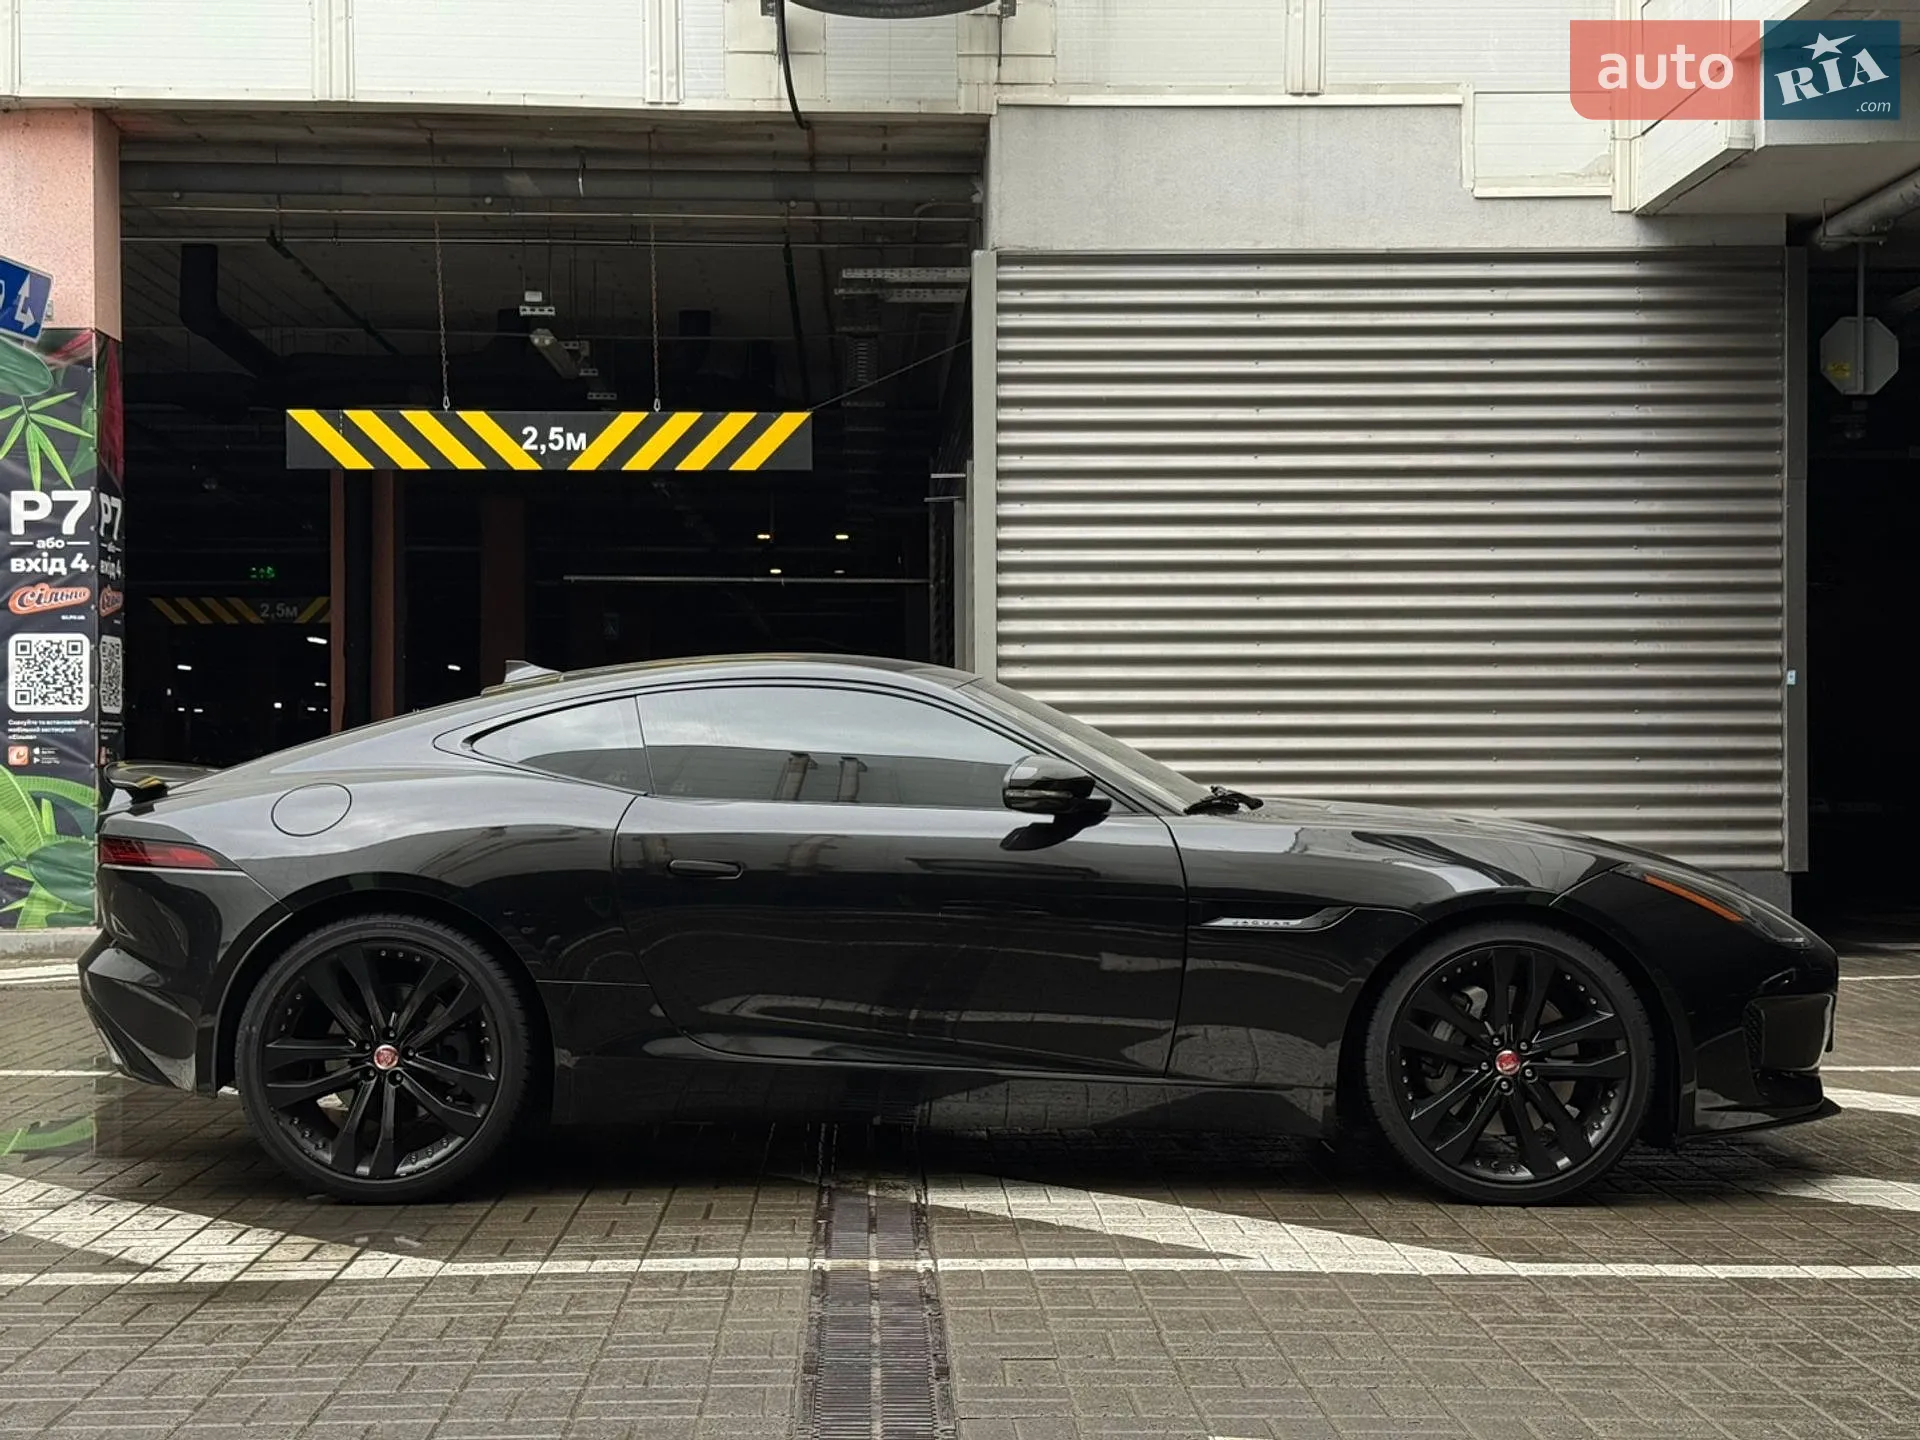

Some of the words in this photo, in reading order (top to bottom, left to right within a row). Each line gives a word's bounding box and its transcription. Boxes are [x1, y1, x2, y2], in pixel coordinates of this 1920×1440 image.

[522, 426, 587, 455] 2,5м
[36, 536, 65, 549] або
[10, 552, 67, 576] вхід
[70, 552, 90, 572] 4
